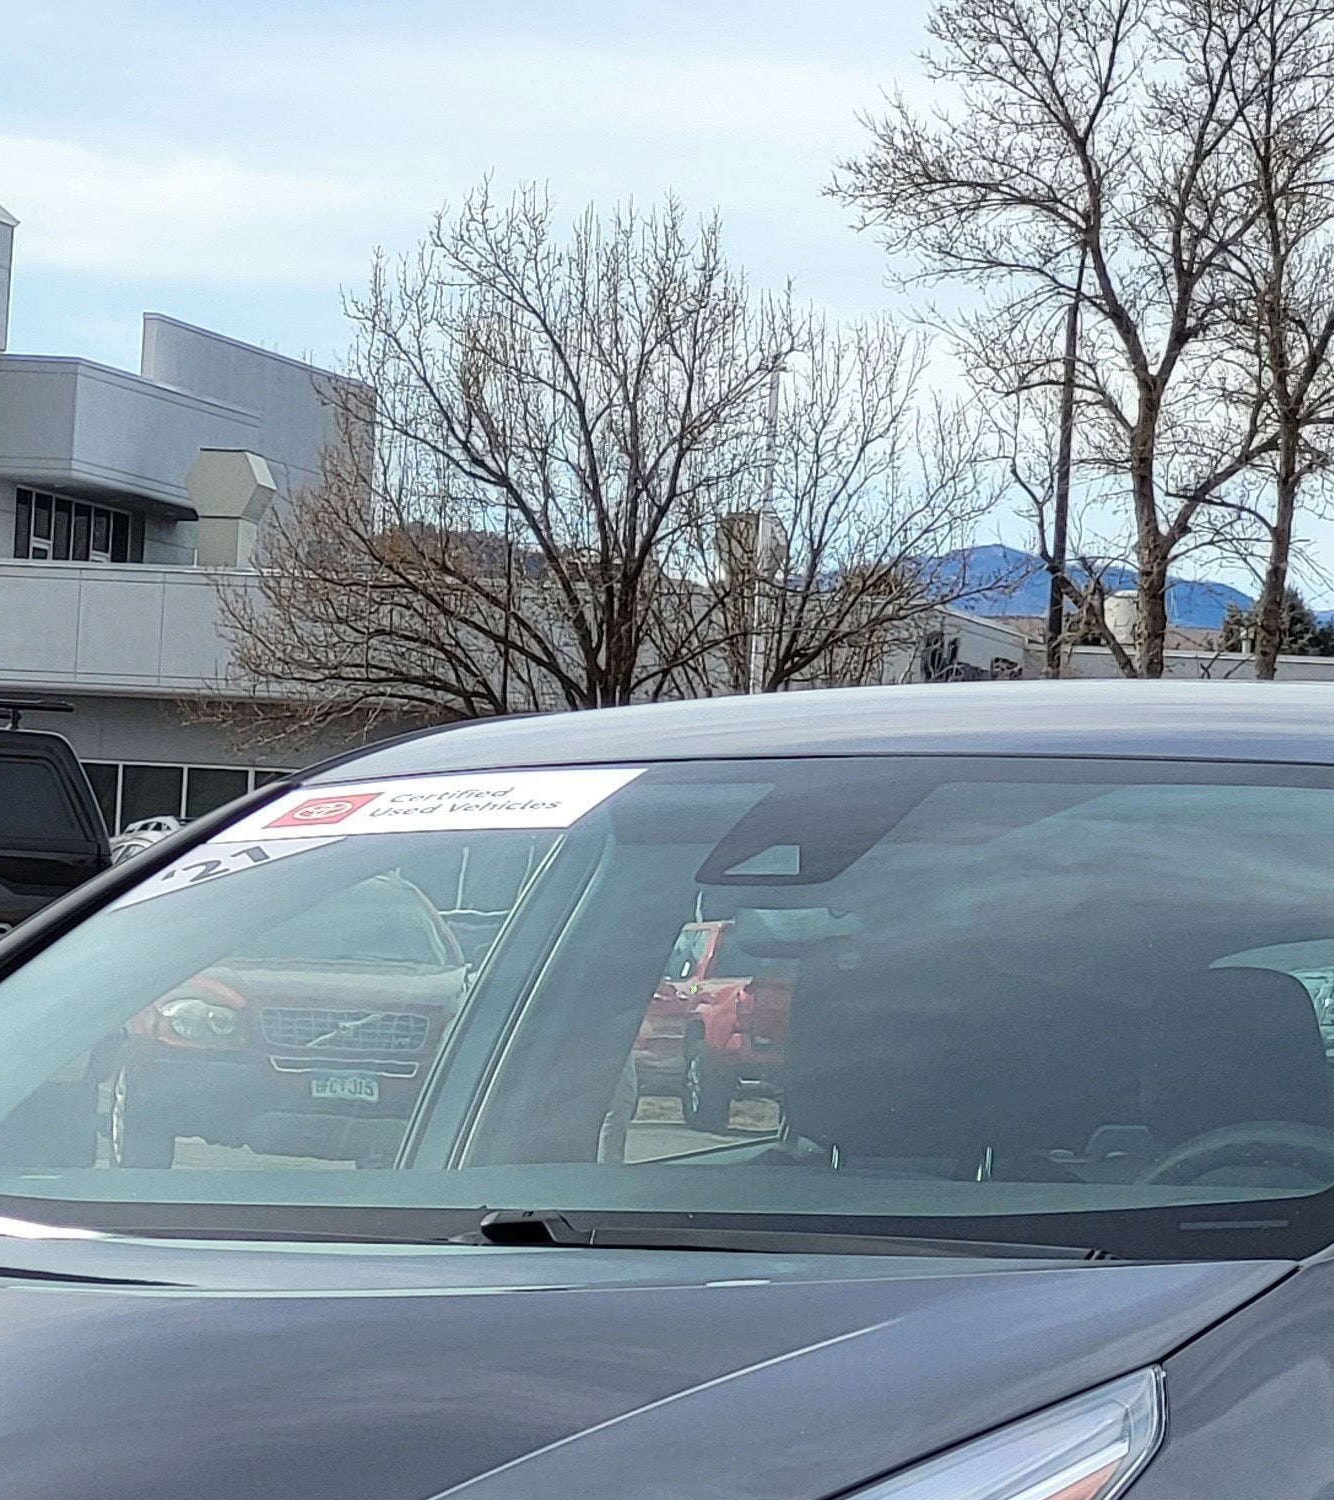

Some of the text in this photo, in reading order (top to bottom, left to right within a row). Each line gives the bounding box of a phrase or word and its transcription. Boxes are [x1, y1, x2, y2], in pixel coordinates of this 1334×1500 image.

[390, 787, 515, 804] Certified
[369, 800, 563, 817] Used Vehicles
